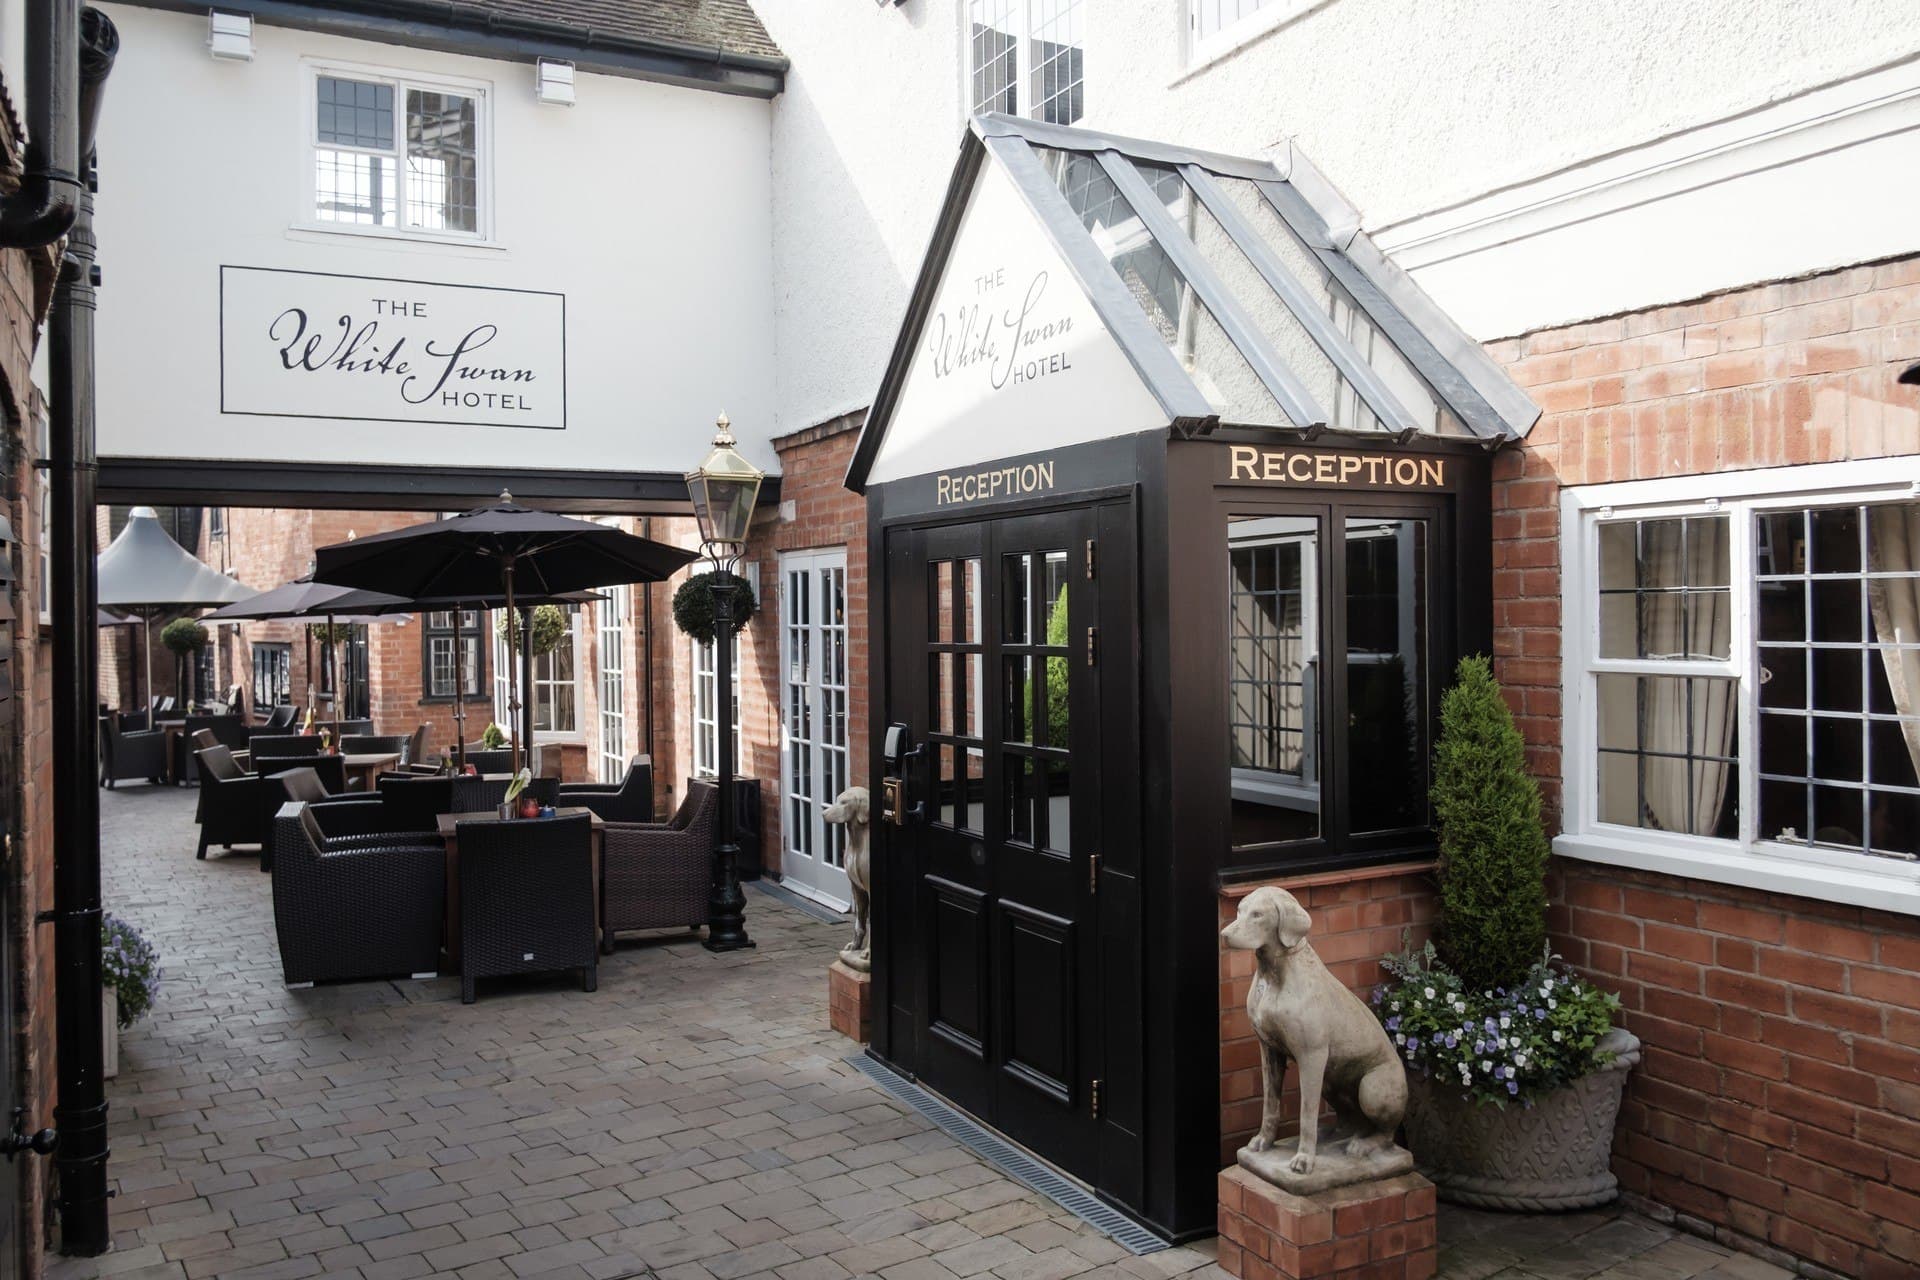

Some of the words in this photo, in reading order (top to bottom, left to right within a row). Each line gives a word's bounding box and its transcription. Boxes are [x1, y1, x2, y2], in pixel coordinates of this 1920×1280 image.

[974, 267, 1005, 295] THE
[371, 299, 427, 318] THE
[929, 303, 996, 379] White
[990, 270, 1074, 390] Swan
[268, 308, 412, 374] White
[400, 324, 537, 404] Swan
[1013, 352, 1072, 385] HOTEL
[442, 390, 532, 411] HOTEL
[936, 460, 1055, 506] RECEPTION
[1228, 445, 1445, 487] RECEPTION
